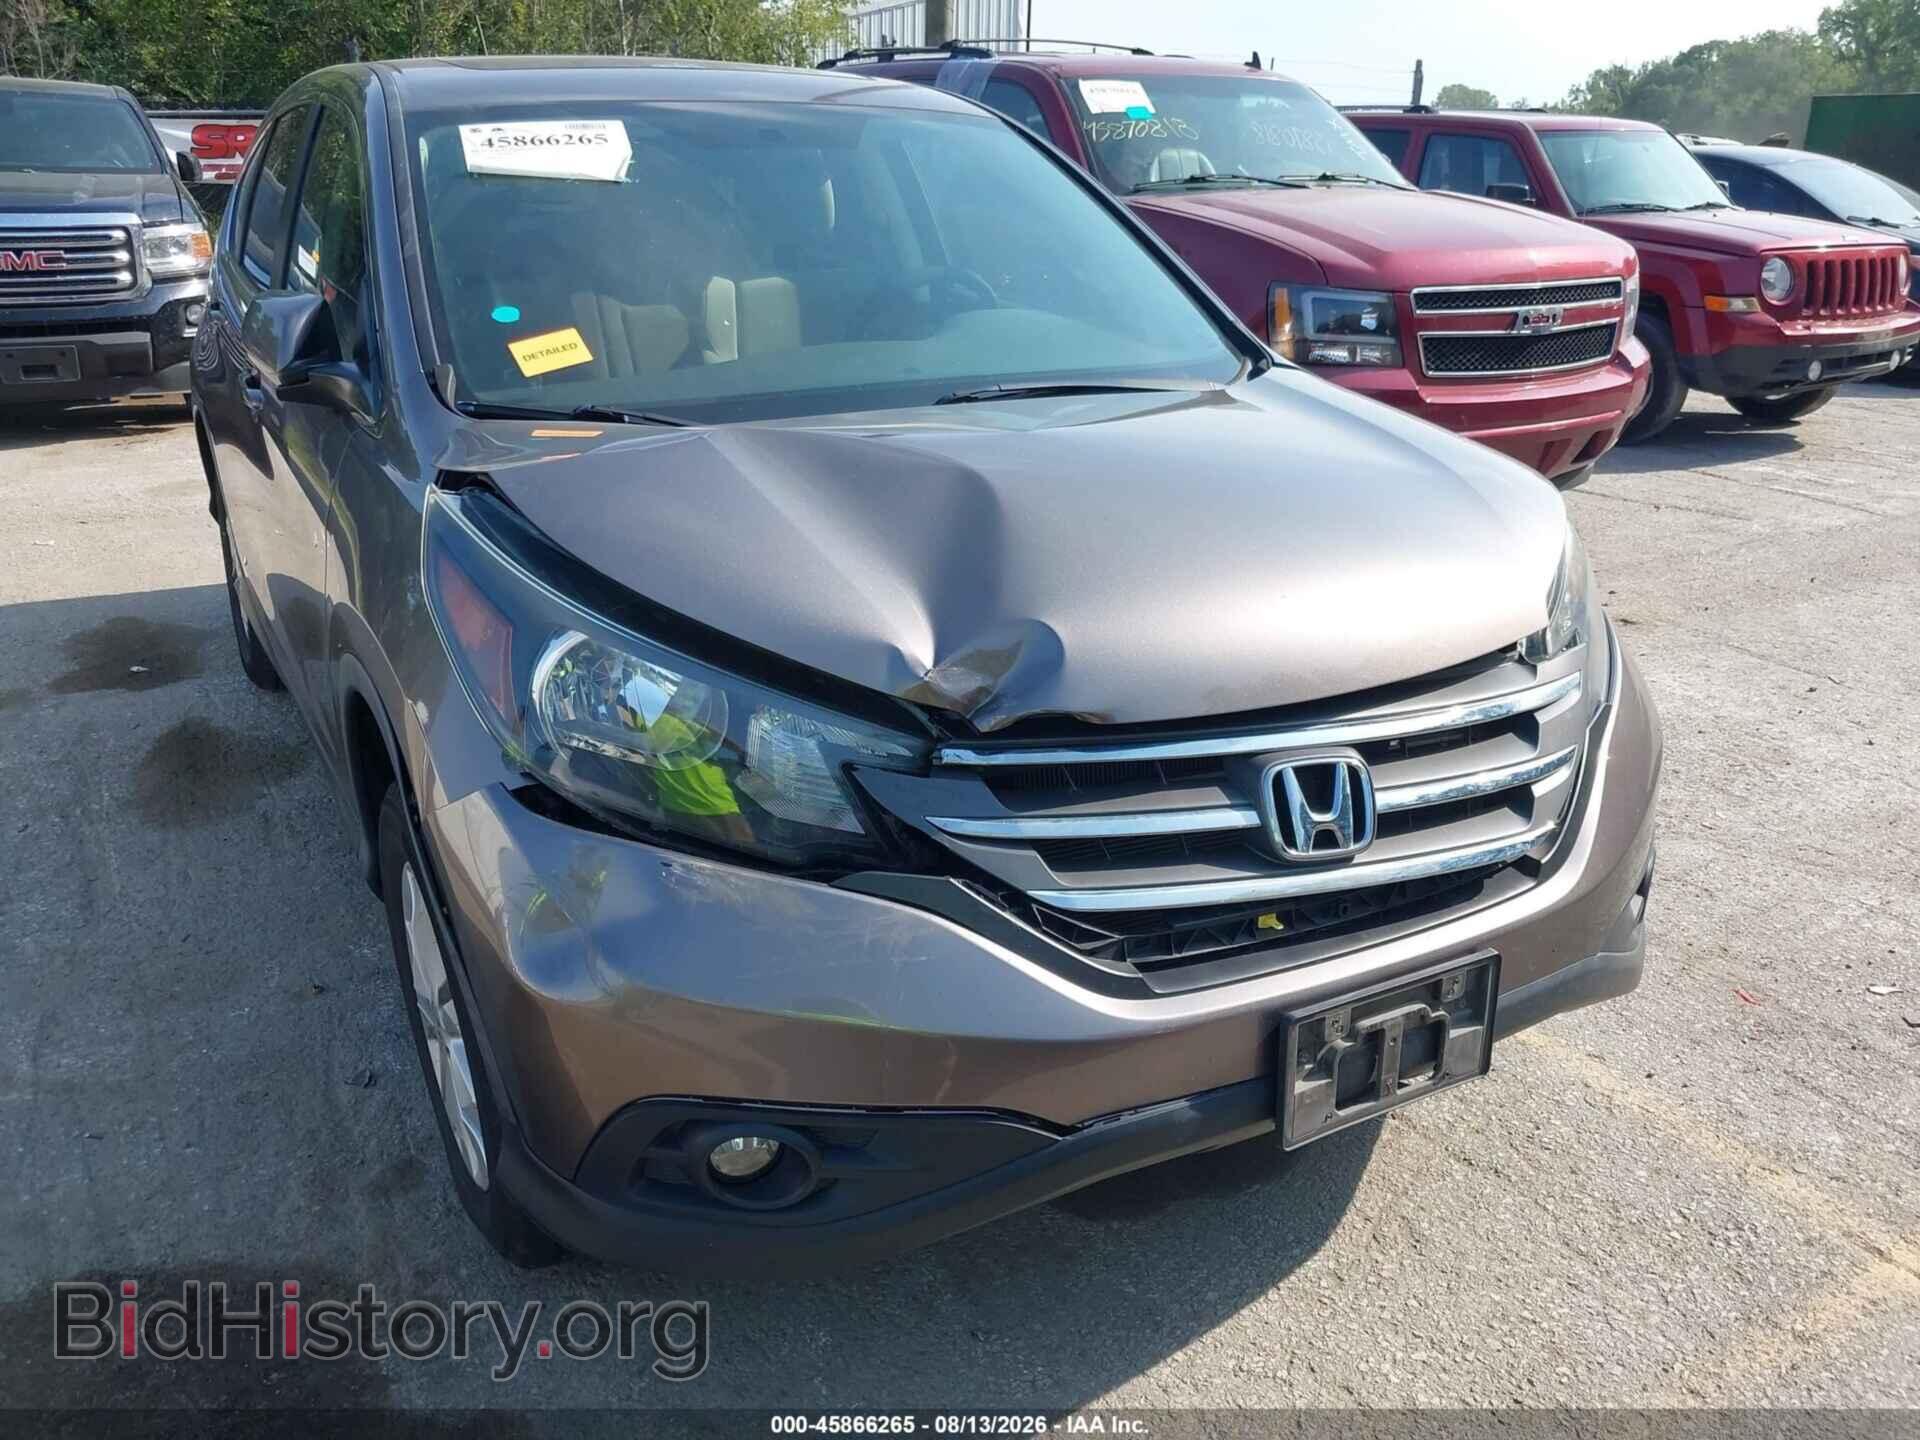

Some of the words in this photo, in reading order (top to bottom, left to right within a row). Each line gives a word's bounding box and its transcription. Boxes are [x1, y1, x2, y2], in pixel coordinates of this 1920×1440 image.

[480, 133, 609, 149] 45866265
[0, 250, 67, 271] MC
[522, 342, 578, 362] DETAILED
